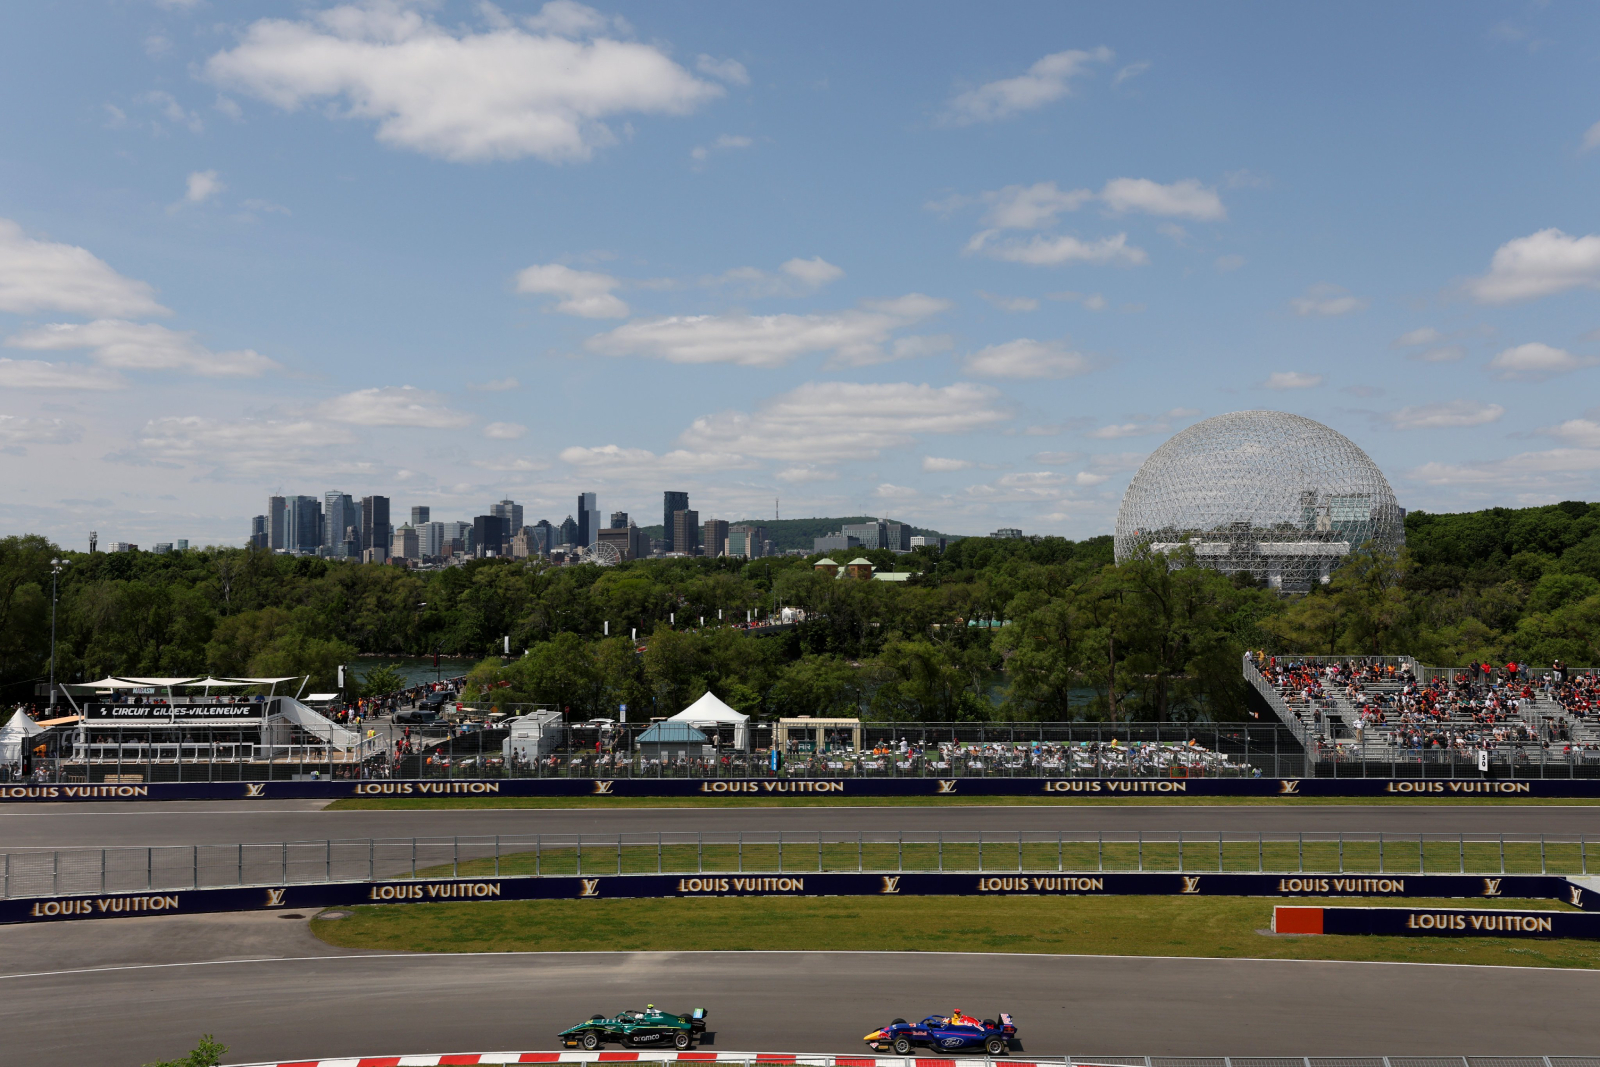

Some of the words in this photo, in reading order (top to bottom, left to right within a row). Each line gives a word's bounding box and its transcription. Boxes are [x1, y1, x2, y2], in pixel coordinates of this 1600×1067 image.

[112, 707, 151, 716] CIRCUIT
[153, 706, 251, 716] GILLES-VILLENEUVE
[1481, 754, 1486, 767] 50
[1, 786, 59, 799] LOUIS
[65, 785, 148, 798] VUITTON
[356, 783, 413, 794] LOUIS
[419, 782, 499, 793] VUITTON
[703, 781, 759, 792] LOUIS
[764, 781, 844, 792] VUITTON
[1046, 781, 1102, 792] LOUIS
[1107, 781, 1187, 792] VUITTON
[1388, 781, 1444, 792] LOUIS
[1449, 781, 1531, 793] VUITTON
[679, 879, 729, 892] LOUIS
[733, 878, 804, 891] VUITTON
[979, 878, 1028, 891] LOUIS
[1033, 877, 1105, 891] VUITTON
[1280, 878, 1329, 892] LOUIS
[1333, 879, 1405, 893] VUITTON
[371, 885, 423, 900] LOUIS
[429, 882, 501, 898] VUITTON
[33, 899, 92, 917] LOUIS
[99, 895, 180, 913] VUITTON
[1409, 913, 1466, 929] LOUIS
[1472, 915, 1552, 931] VUITTON
[633, 1034, 660, 1042] aramco
